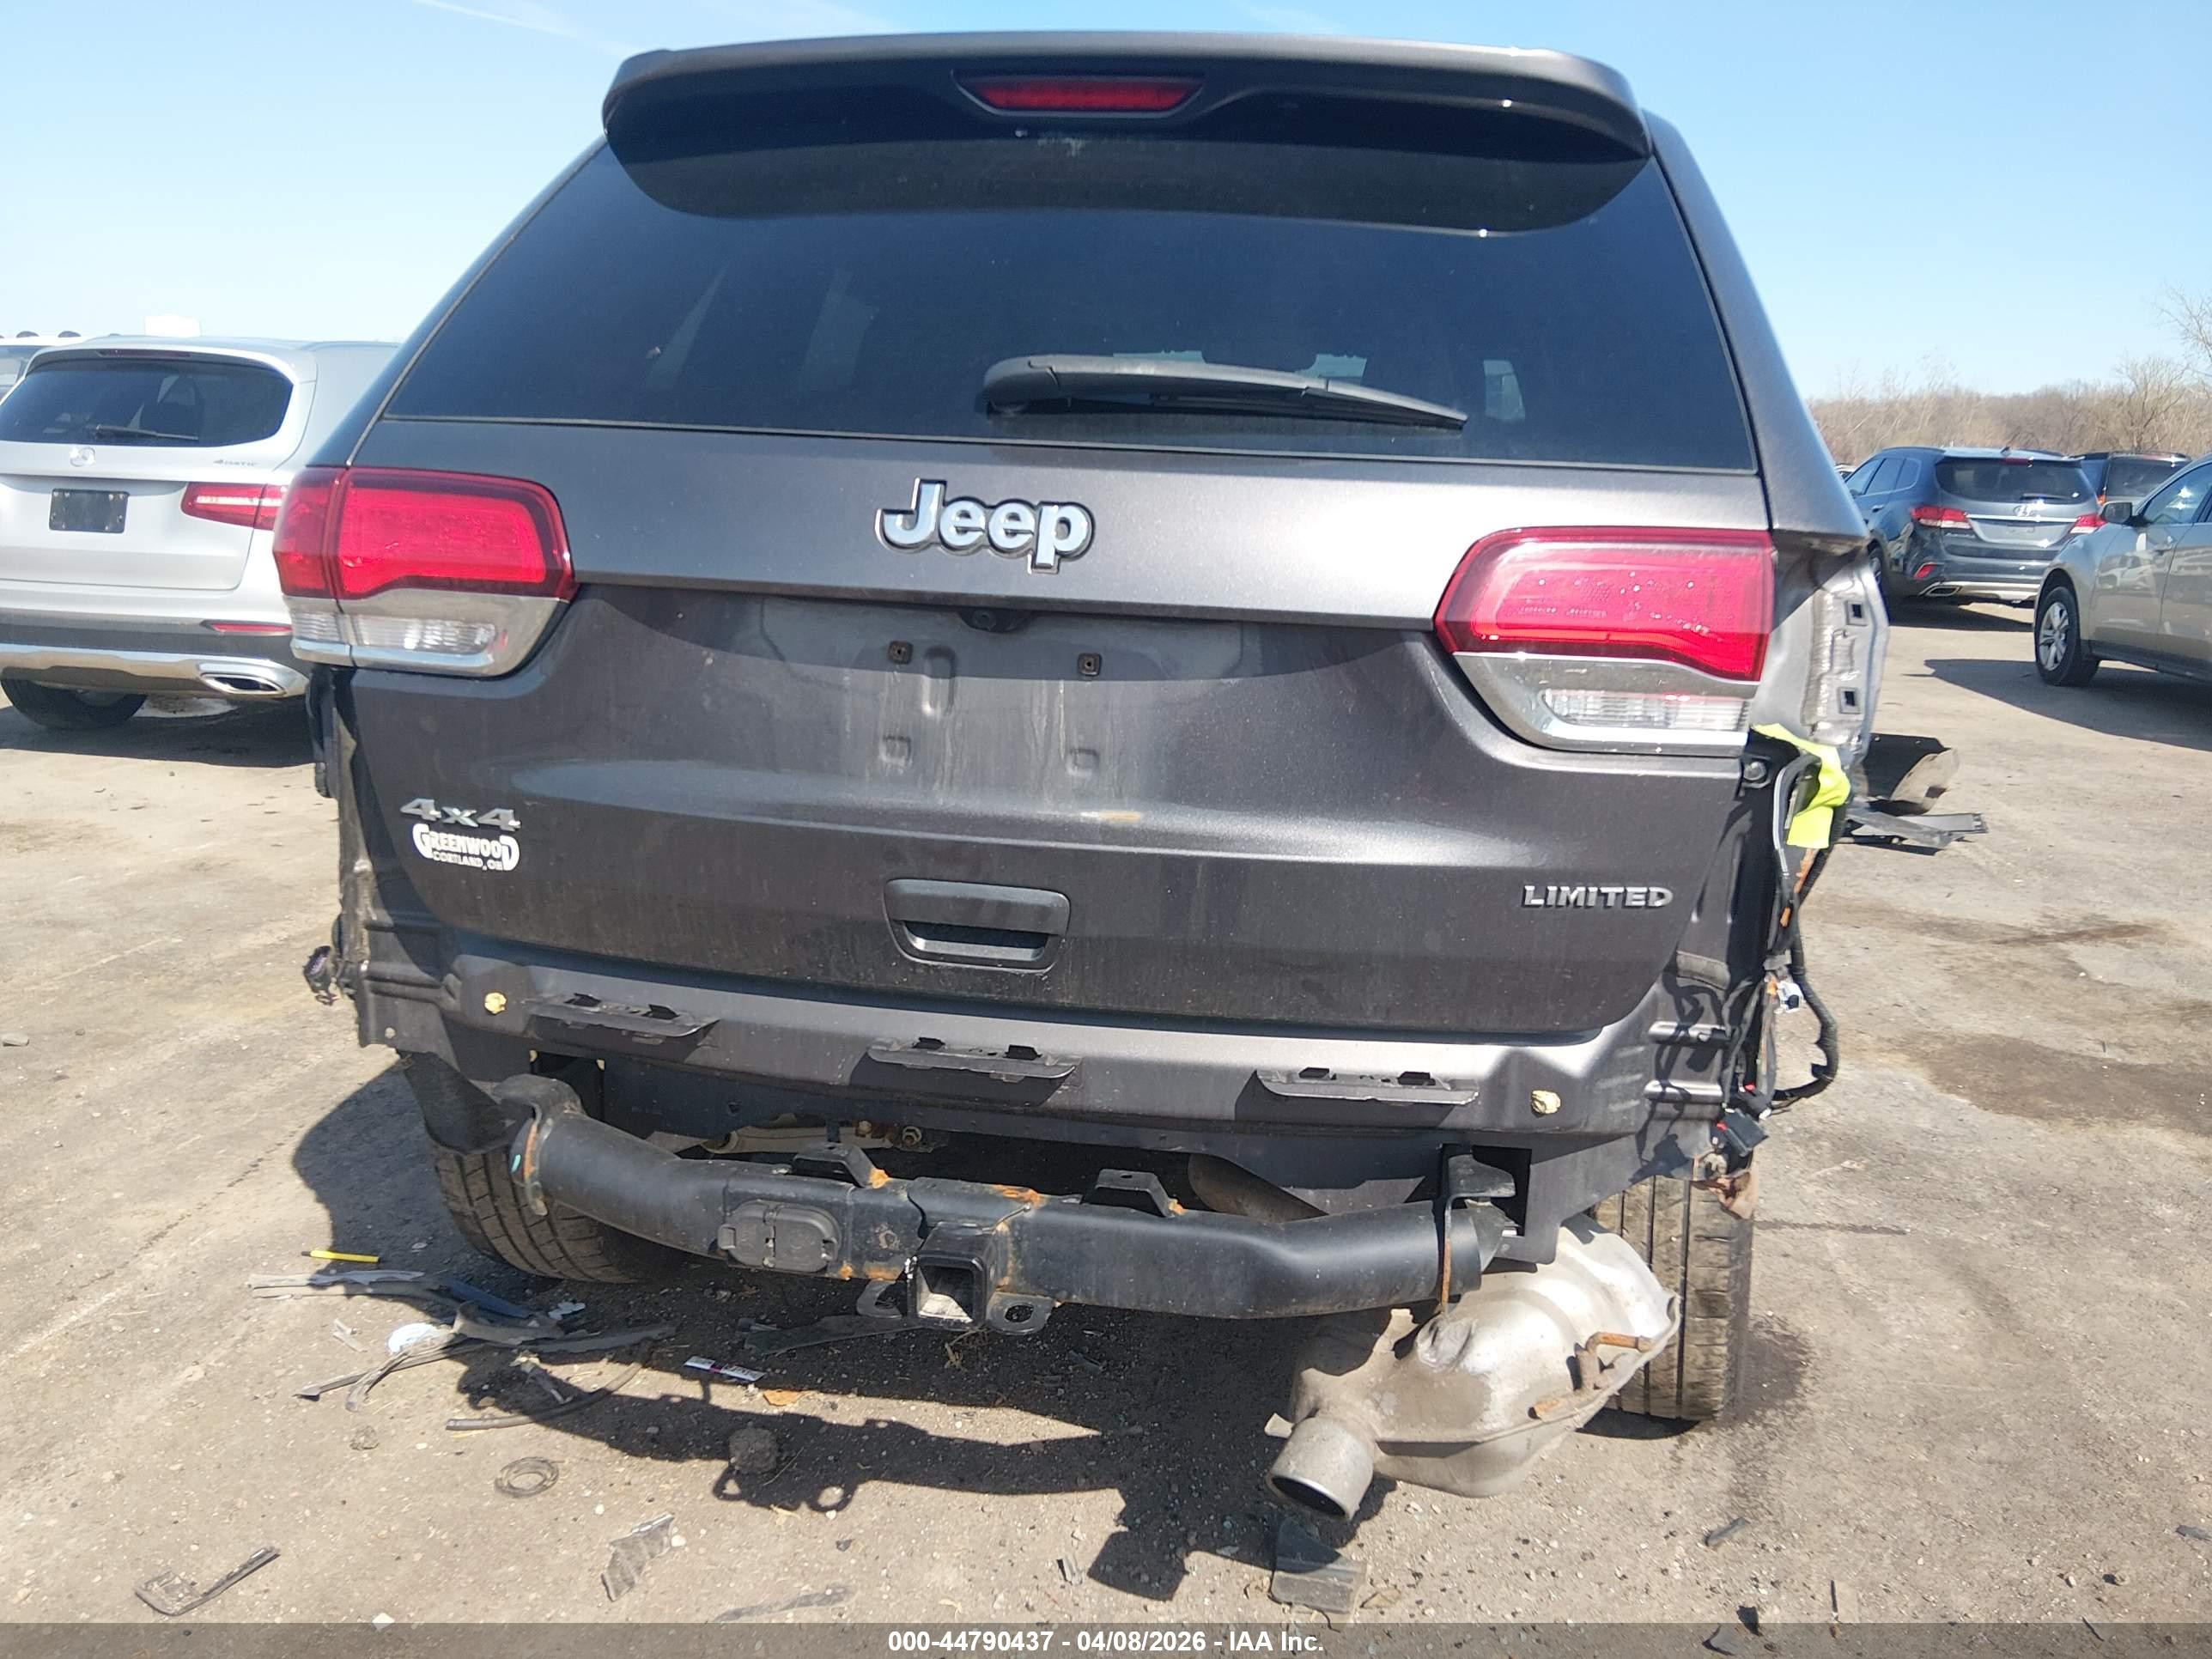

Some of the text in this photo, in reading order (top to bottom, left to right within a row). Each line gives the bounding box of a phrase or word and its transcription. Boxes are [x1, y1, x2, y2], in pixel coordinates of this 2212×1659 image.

[875, 477, 1095, 574] Jeep
[412, 823, 520, 871] GREENWOOD
[1522, 885, 1674, 907] LIMITED
